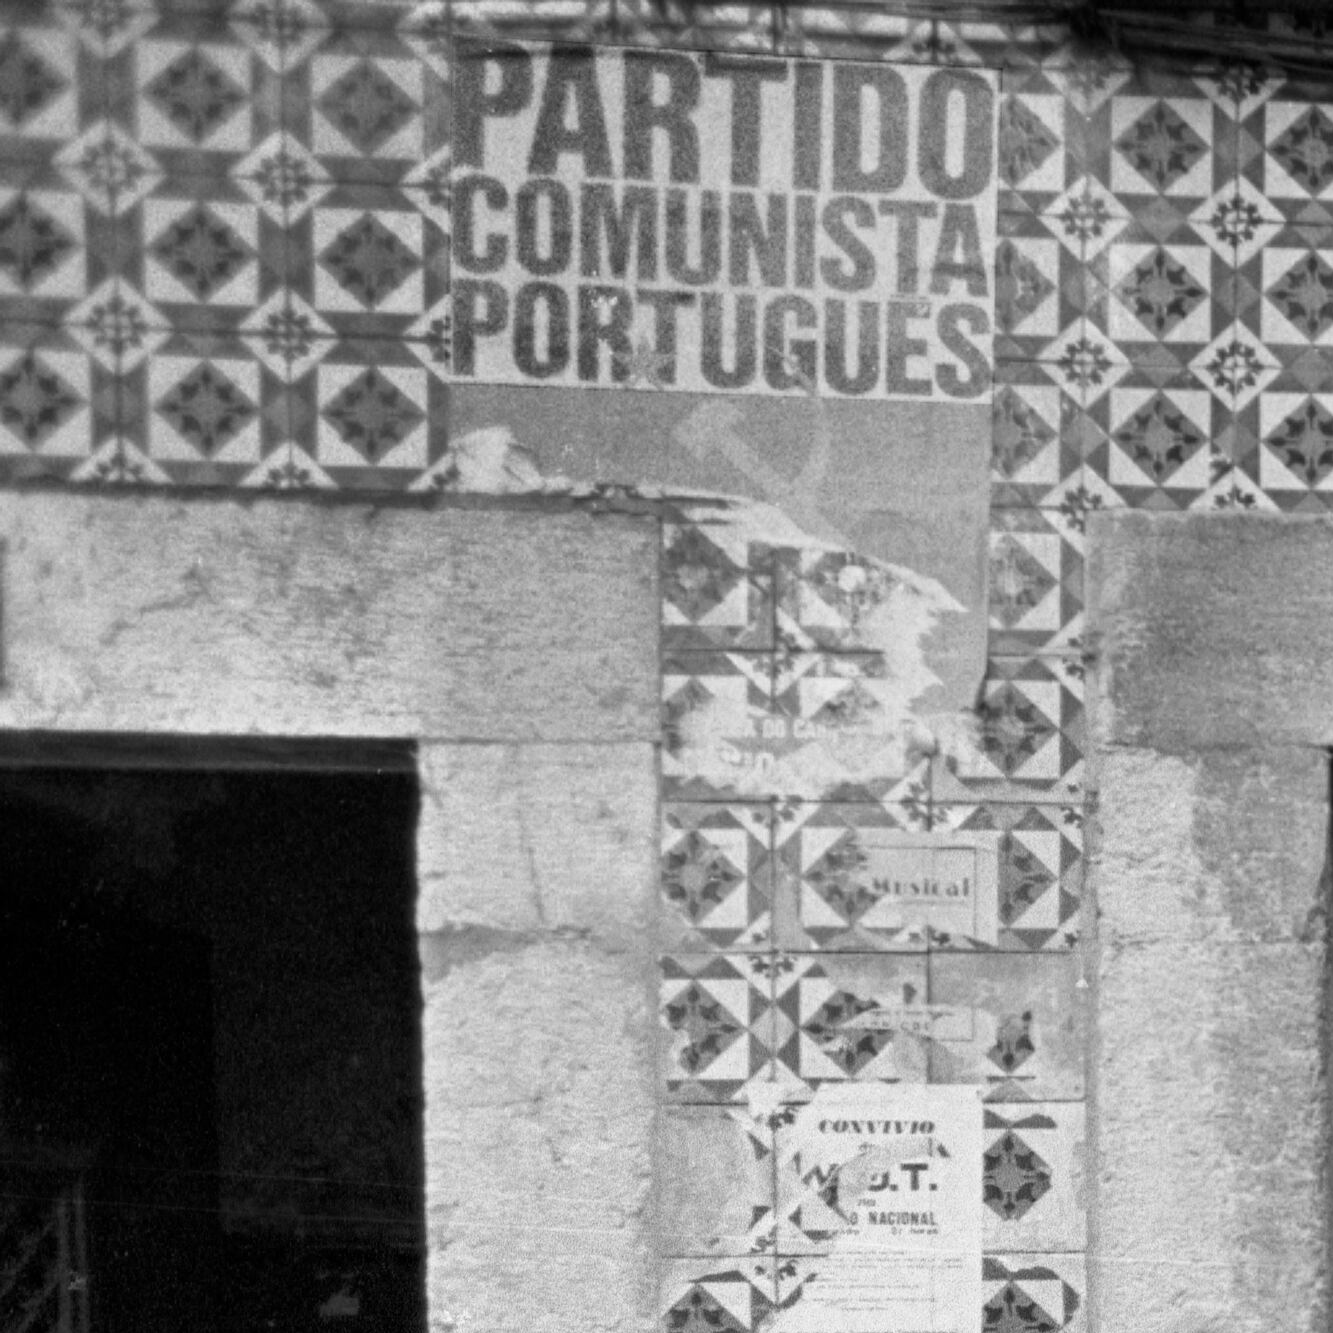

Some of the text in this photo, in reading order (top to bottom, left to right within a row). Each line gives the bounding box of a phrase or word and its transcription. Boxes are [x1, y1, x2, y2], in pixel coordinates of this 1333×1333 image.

[453, 38, 994, 199] PARTIDO
[452, 174, 990, 298] COMUNISTA
[452, 278, 993, 399] PORTUGUES
[872, 877, 969, 898] Musical
[818, 1119, 936, 1135] CONVIVIO
[867, 1210, 938, 1226] NACIONAL
